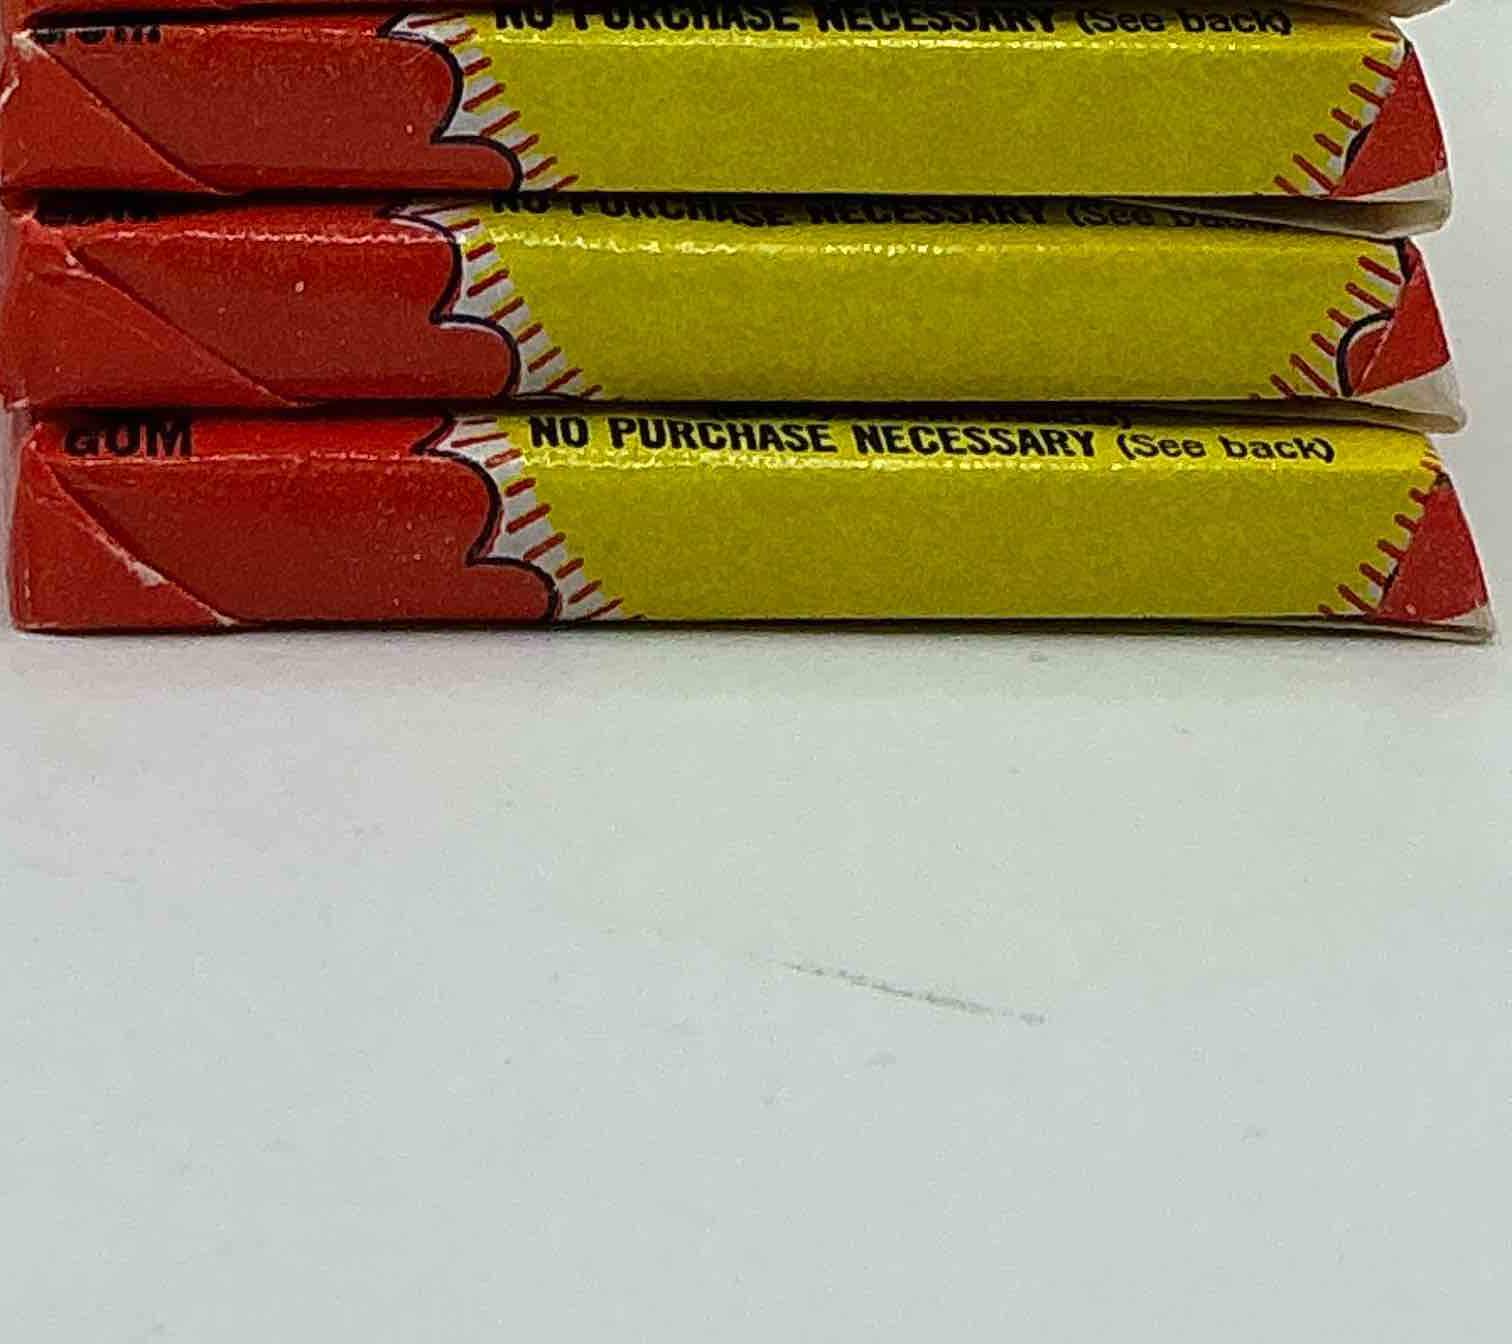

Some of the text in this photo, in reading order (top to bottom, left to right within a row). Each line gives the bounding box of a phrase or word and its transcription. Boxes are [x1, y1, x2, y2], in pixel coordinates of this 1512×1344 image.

[568, 4, 799, 32] PURCHASE
[817, 0, 1056, 33] NECESSARY
[1076, 7, 1169, 34] (See
[1181, 4, 1292, 35] back)
[530, 416, 591, 449] NO
[608, 417, 837, 454] PURCHASE
[851, 422, 1096, 459] NECESSARY
[1118, 431, 1205, 460] (See
[1222, 430, 1335, 462] back)
